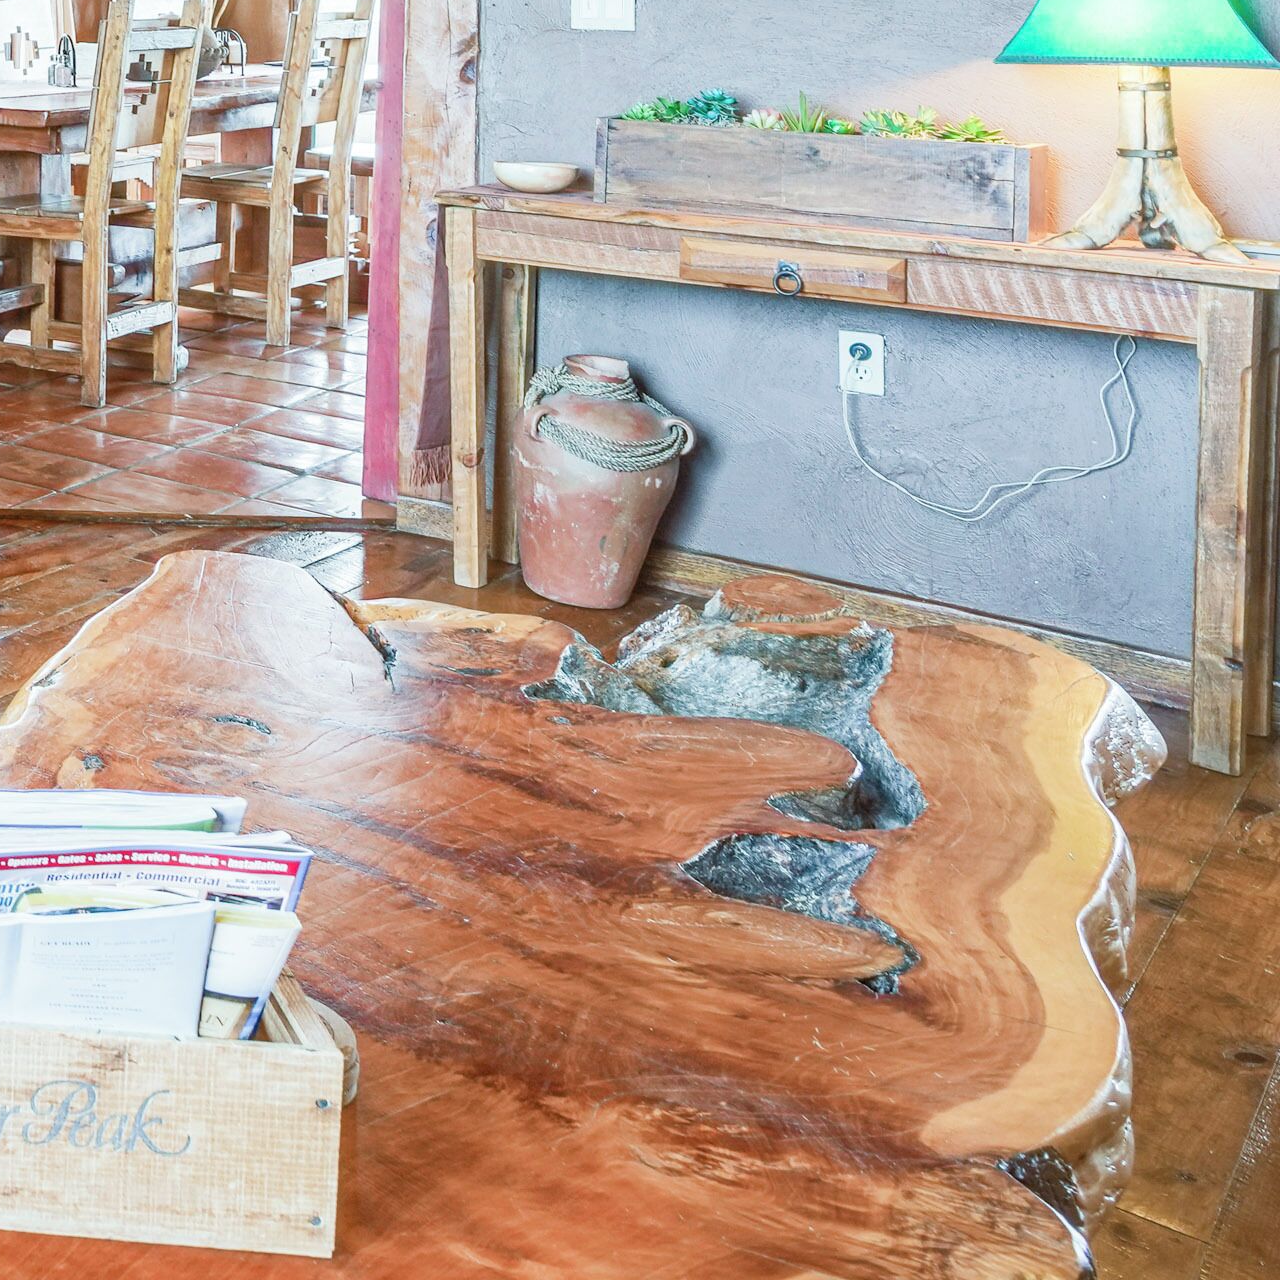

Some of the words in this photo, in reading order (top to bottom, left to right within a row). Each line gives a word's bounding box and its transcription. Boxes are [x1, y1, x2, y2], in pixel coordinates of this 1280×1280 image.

[7, 856, 49, 868] Openers
[57, 854, 87, 865] Gates
[94, 852, 123, 863] Sales
[130, 852, 170, 863] Service
[178, 853, 220, 867] Repairs
[227, 857, 289, 873] Installation
[46, 871, 122, 883] Residential
[136, 871, 221, 887] Commercial
[21, 1079, 192, 1157] Peak
